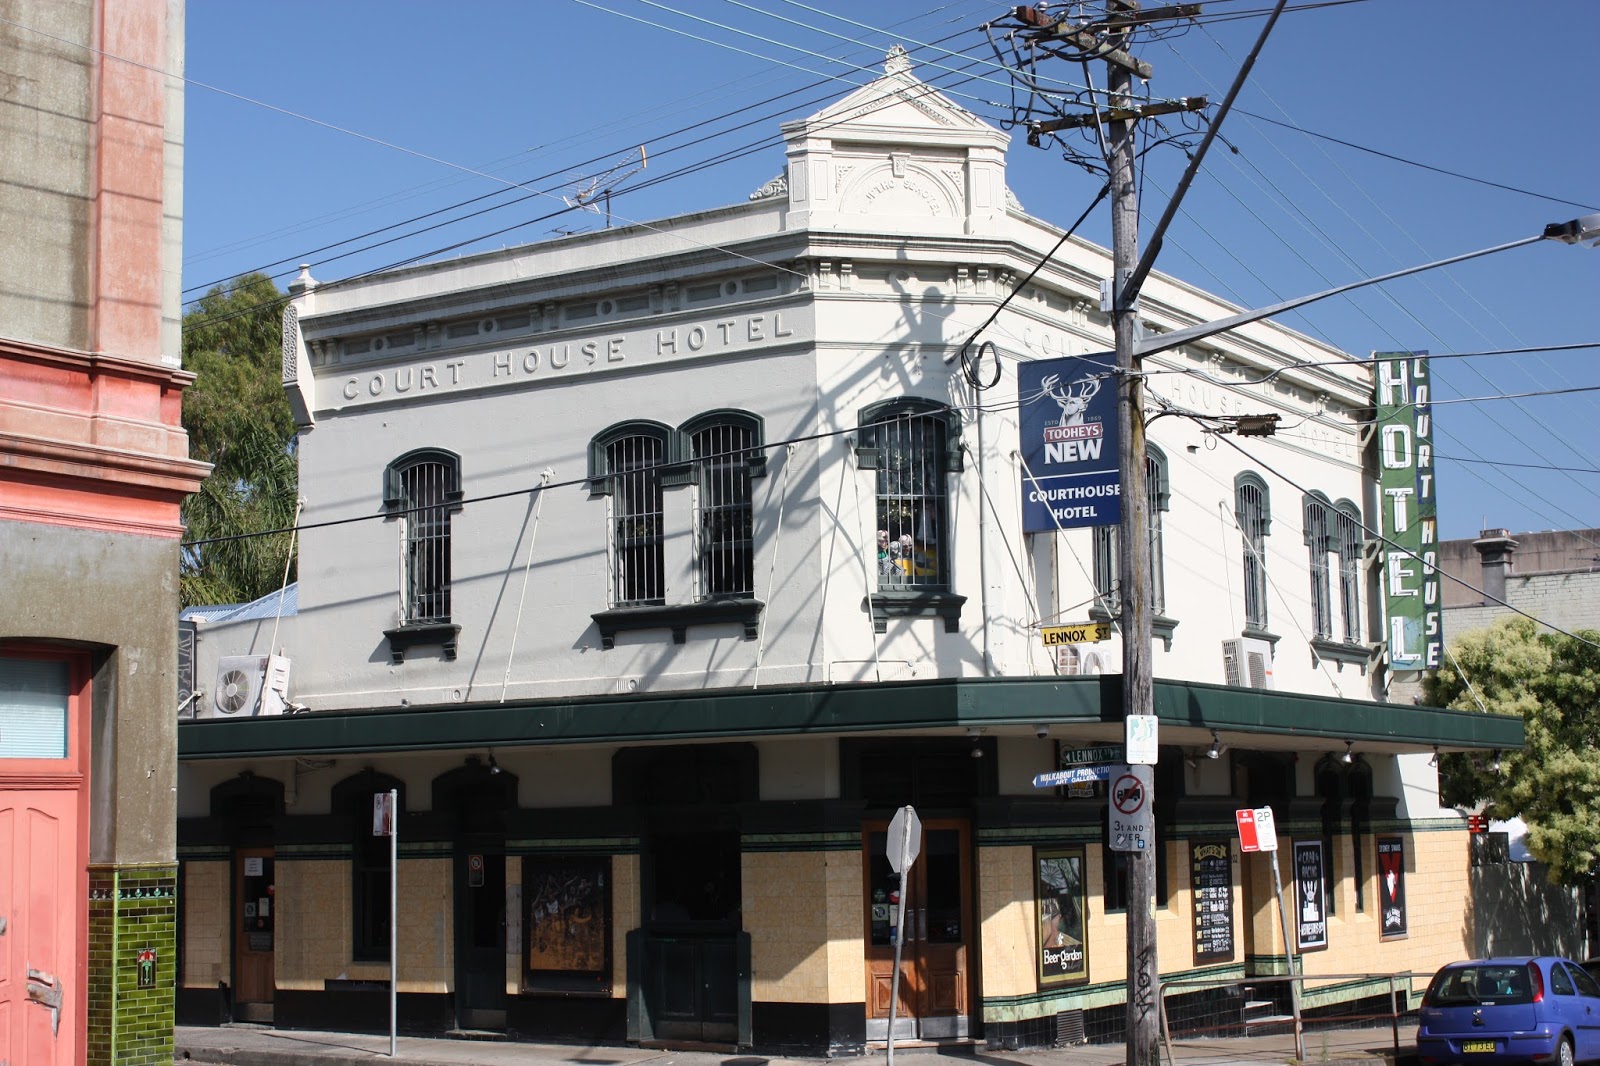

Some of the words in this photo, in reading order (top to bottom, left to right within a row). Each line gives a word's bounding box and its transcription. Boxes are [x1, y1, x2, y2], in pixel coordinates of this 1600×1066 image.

[343, 359, 465, 399] COURT
[493, 336, 626, 377] HOUSE
[656, 312, 794, 356] HOTEL
[1046, 424, 1100, 440] TOOHEYS
[1413, 354, 1432, 498] COURT
[1044, 438, 1104, 465] NEW
[1029, 484, 1120, 503] COURTHOUSE
[1054, 506, 1098, 521] HOTEL
[1378, 360, 1422, 661] HOTEL
[1421, 520, 1440, 666] HOUSE
[1043, 629, 1087, 645] LENNOX
[1071, 749, 1103, 763] LENNOX
[1040, 770, 1075, 782] WALKABOUT
[1077, 765, 1112, 777] PRODUCTIO
[1071, 774, 1098, 783] GALLERY
[1256, 811, 1271, 822] 2P
[1114, 821, 1125, 832] 3t
[1126, 824, 1144, 832] AND
[1116, 833, 1141, 841] OVER
[1043, 949, 1061, 965] Beer
